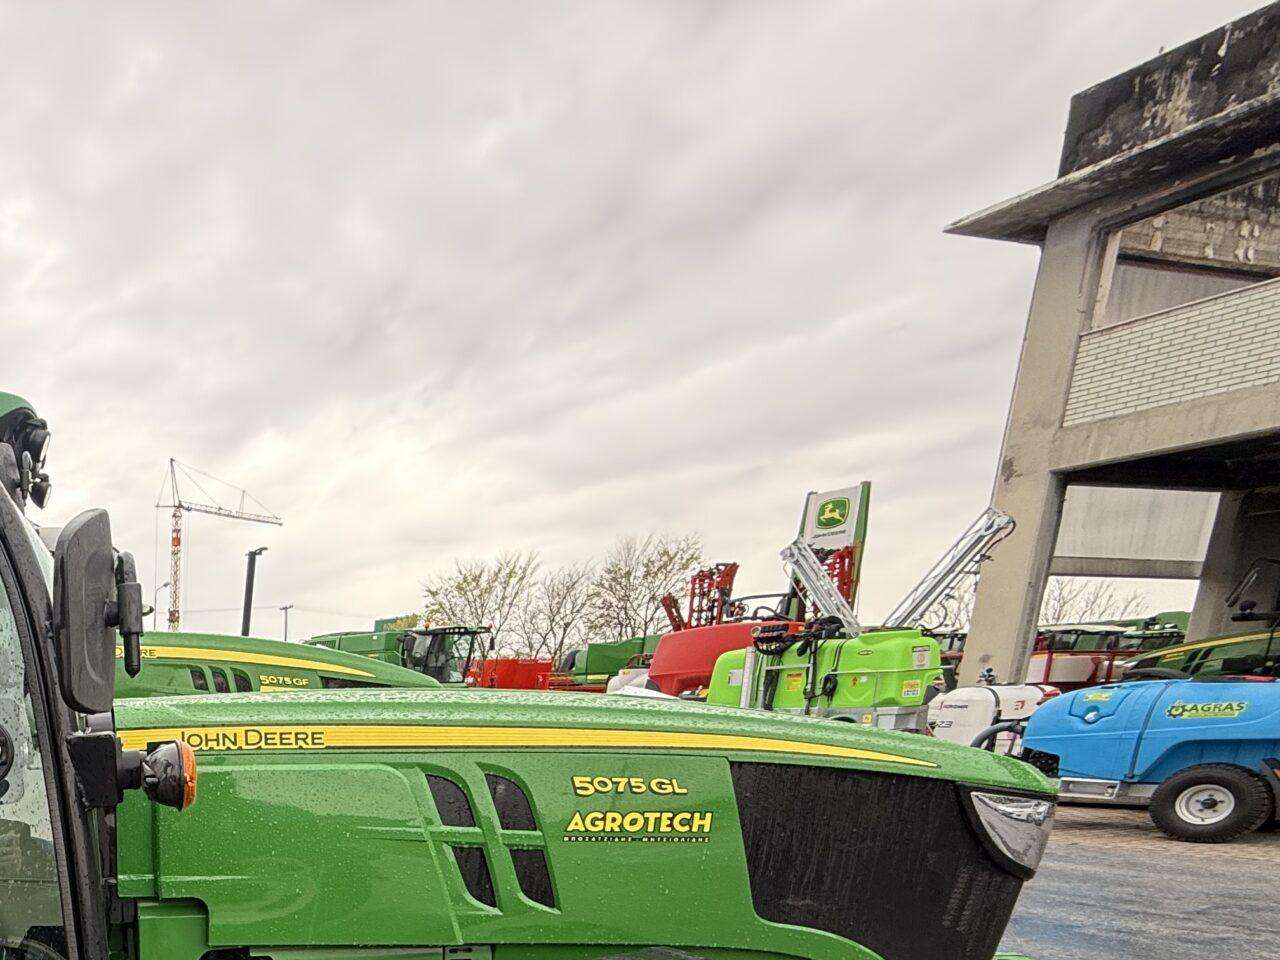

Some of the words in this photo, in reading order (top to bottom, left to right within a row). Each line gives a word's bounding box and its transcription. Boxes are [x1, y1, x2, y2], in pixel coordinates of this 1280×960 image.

[1186, 702, 1245, 713] AGRAS
[245, 730, 325, 747] DEERE
[565, 811, 713, 833] AGROTECH
